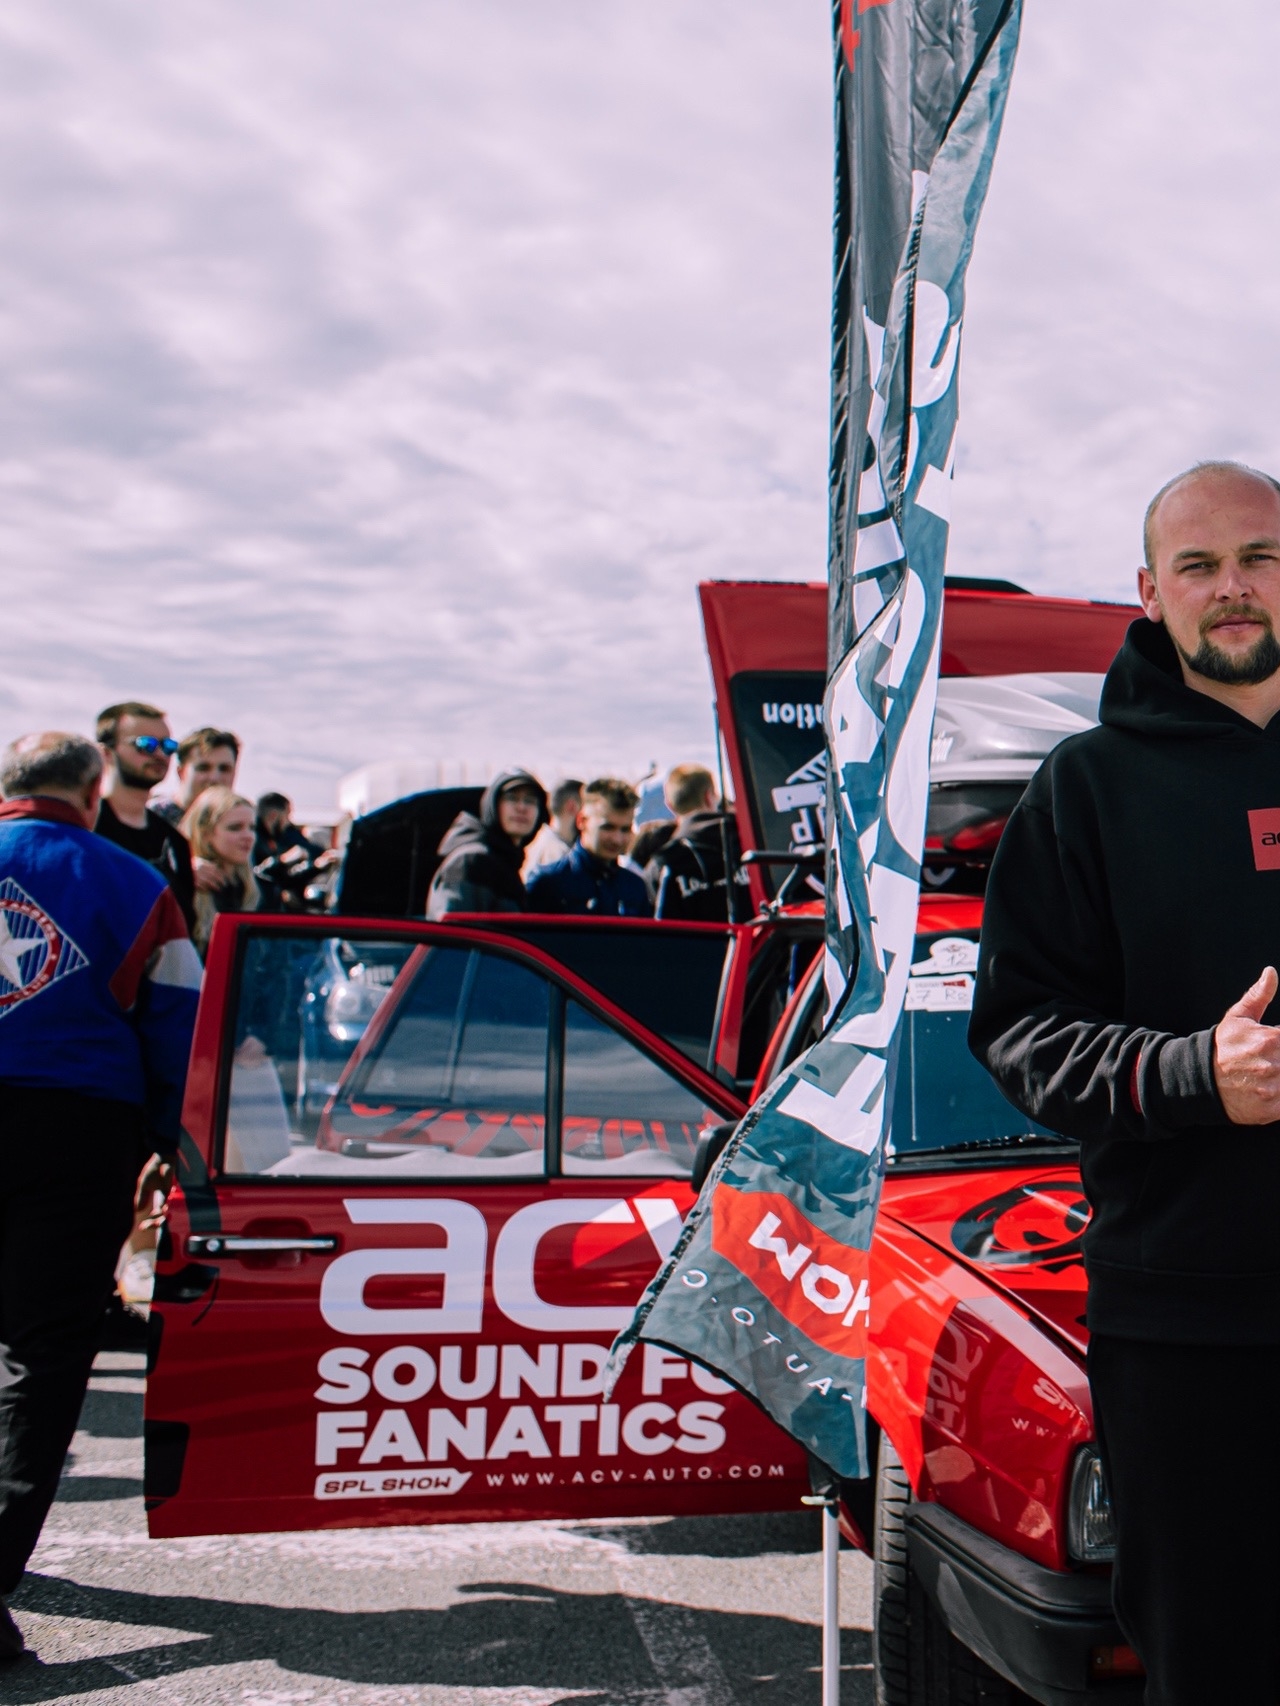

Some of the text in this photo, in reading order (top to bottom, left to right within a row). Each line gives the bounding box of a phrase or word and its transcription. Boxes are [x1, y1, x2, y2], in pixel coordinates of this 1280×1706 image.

[314, 1343, 608, 1404] SOUND
[315, 1400, 727, 1466] FANATICS
[324, 1475, 452, 1494] SPL SHOW
[486, 1464, 786, 1488] WWW.ACV-AUTO.COM
